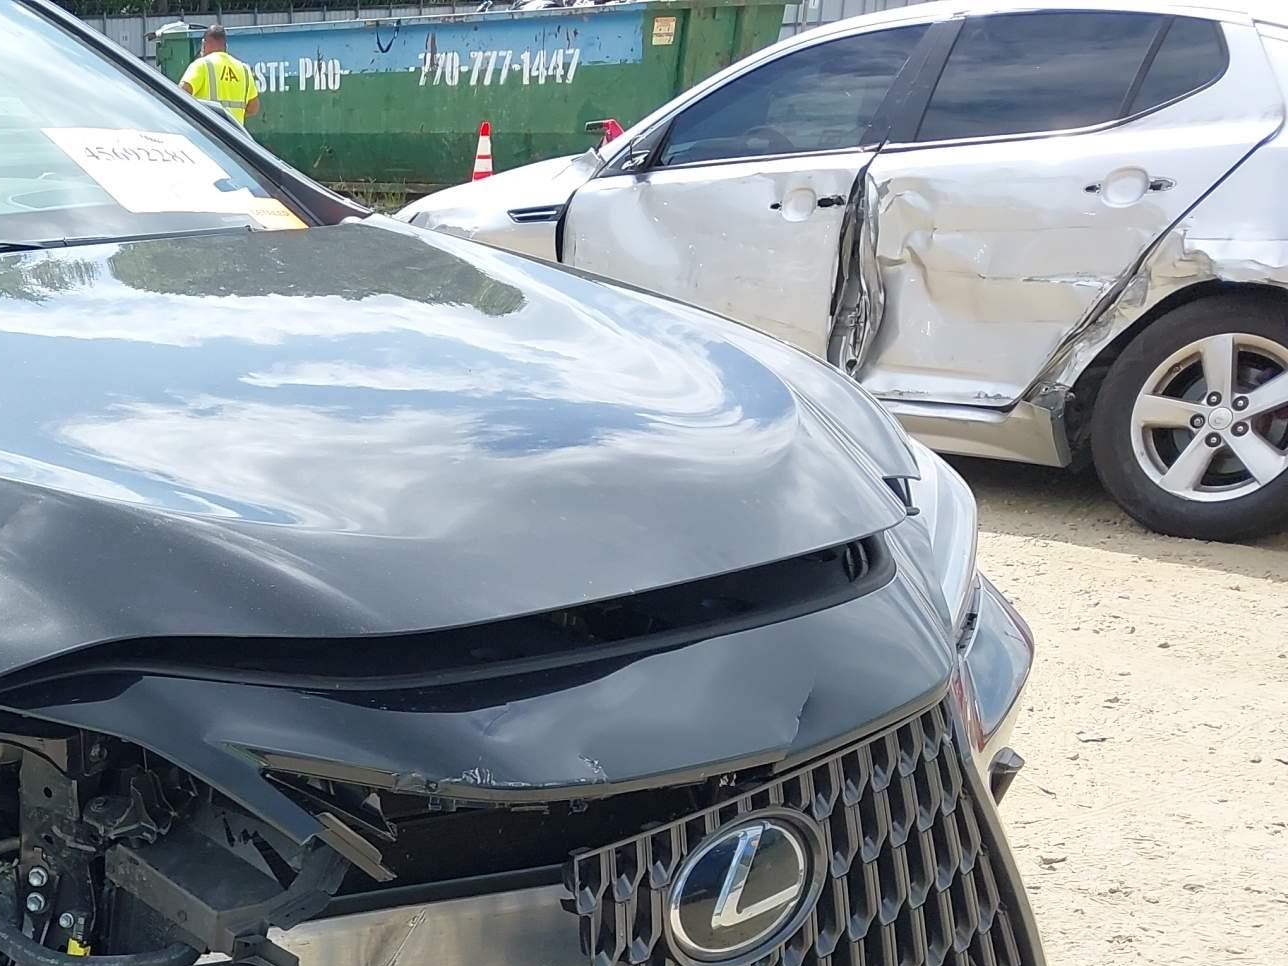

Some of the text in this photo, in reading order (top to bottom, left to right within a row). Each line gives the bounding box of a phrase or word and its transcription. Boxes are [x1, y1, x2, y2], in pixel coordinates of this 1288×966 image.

[252, 48, 581, 93] STE PRO 770-777-1447
